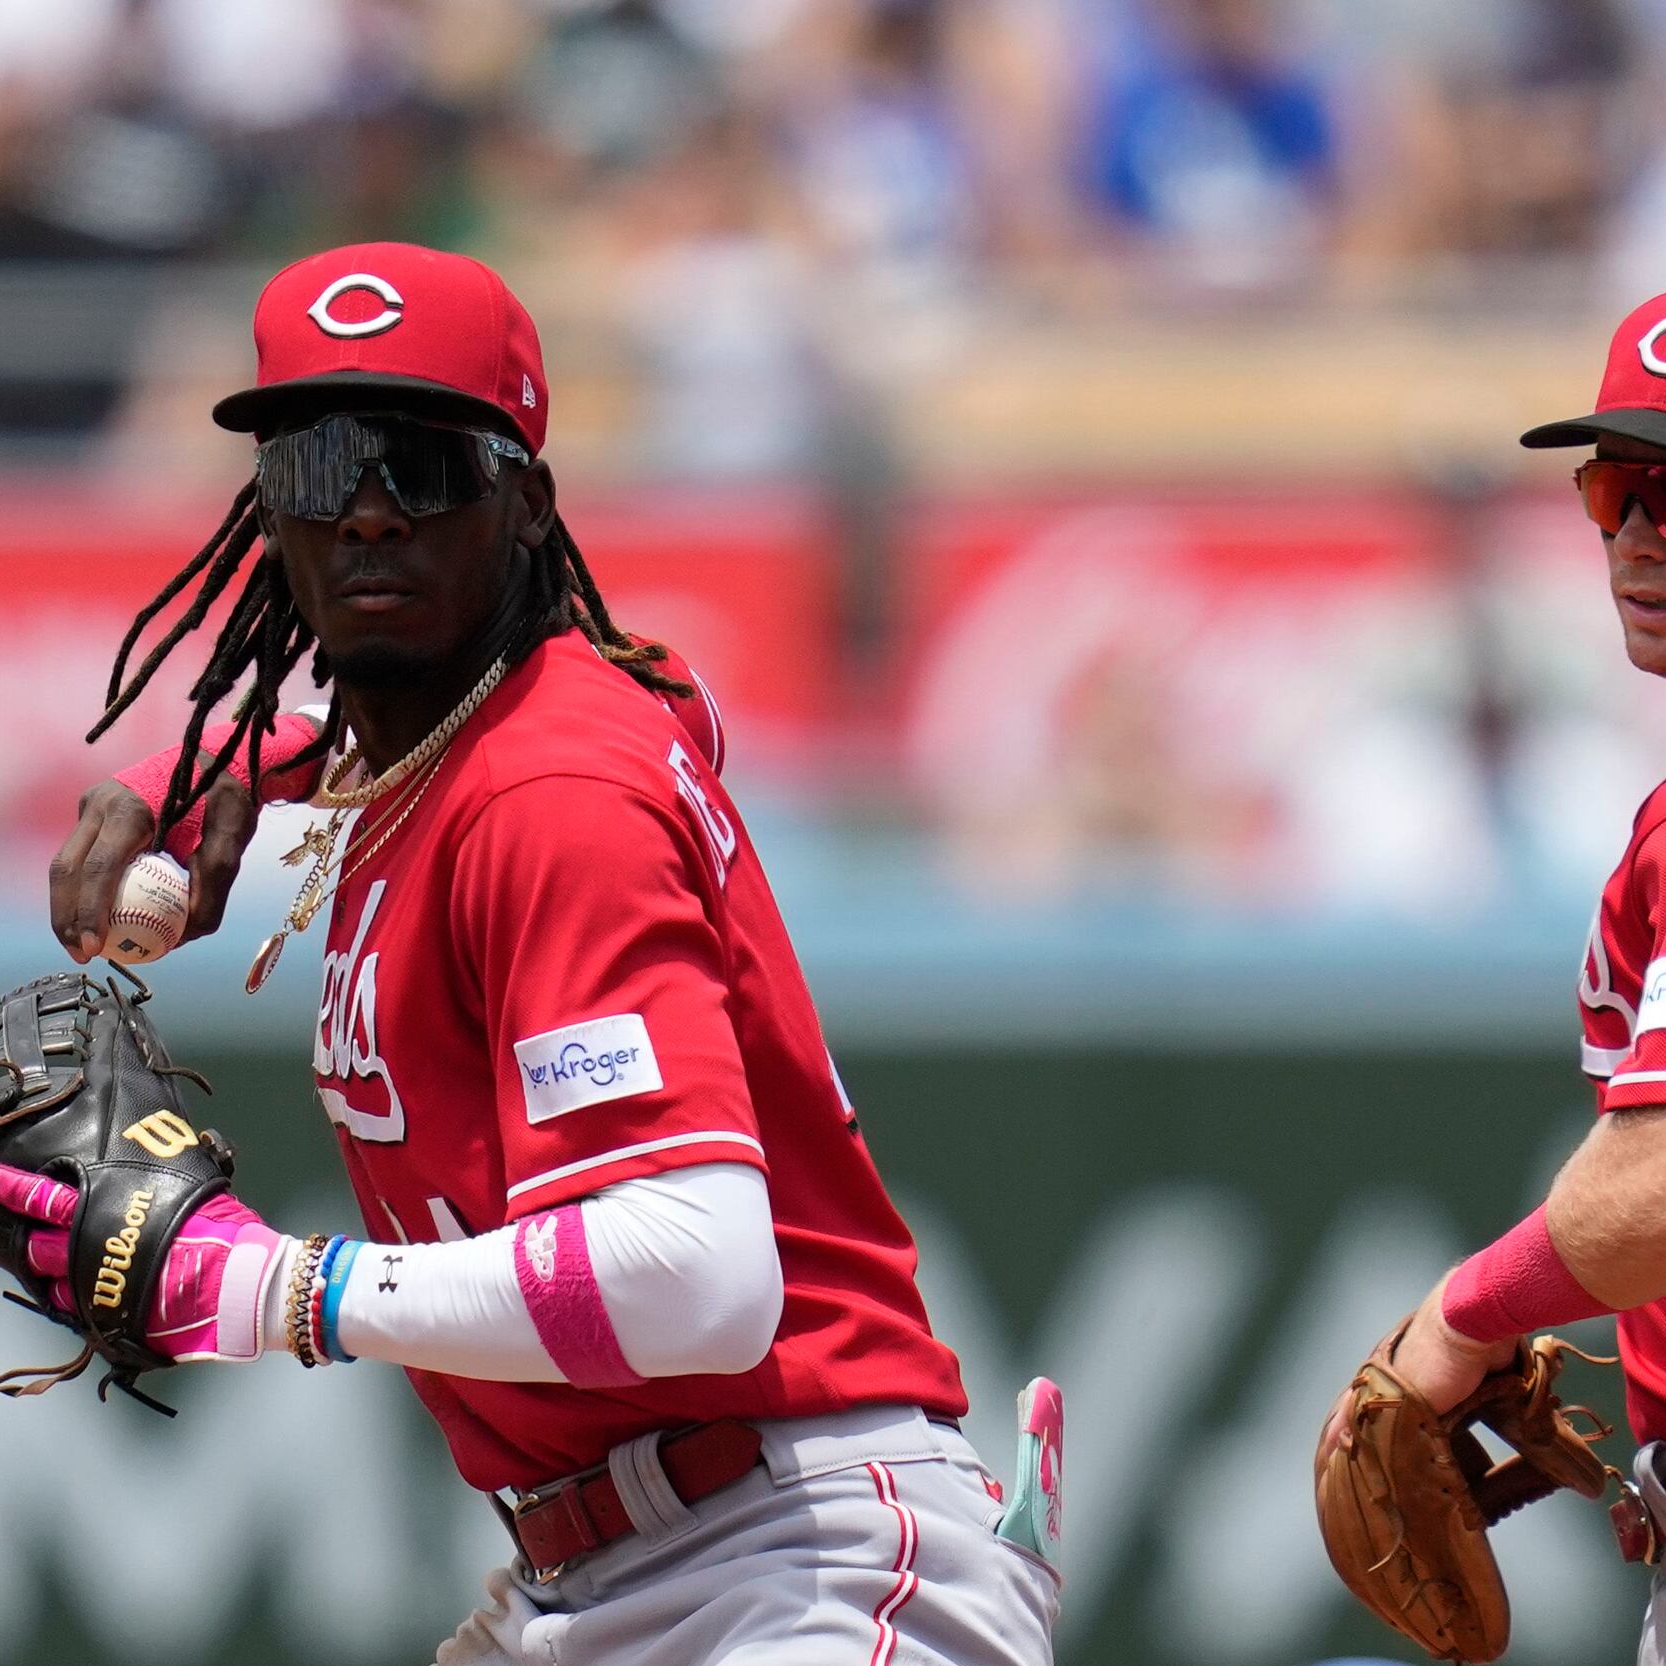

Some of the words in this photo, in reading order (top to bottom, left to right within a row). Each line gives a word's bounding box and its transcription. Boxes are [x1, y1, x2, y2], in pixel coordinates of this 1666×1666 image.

[307, 272, 404, 338] C
[551, 1042, 640, 1087] Kroger
[122, 1109, 199, 1158] W
[93, 1188, 154, 1308] Wilson
